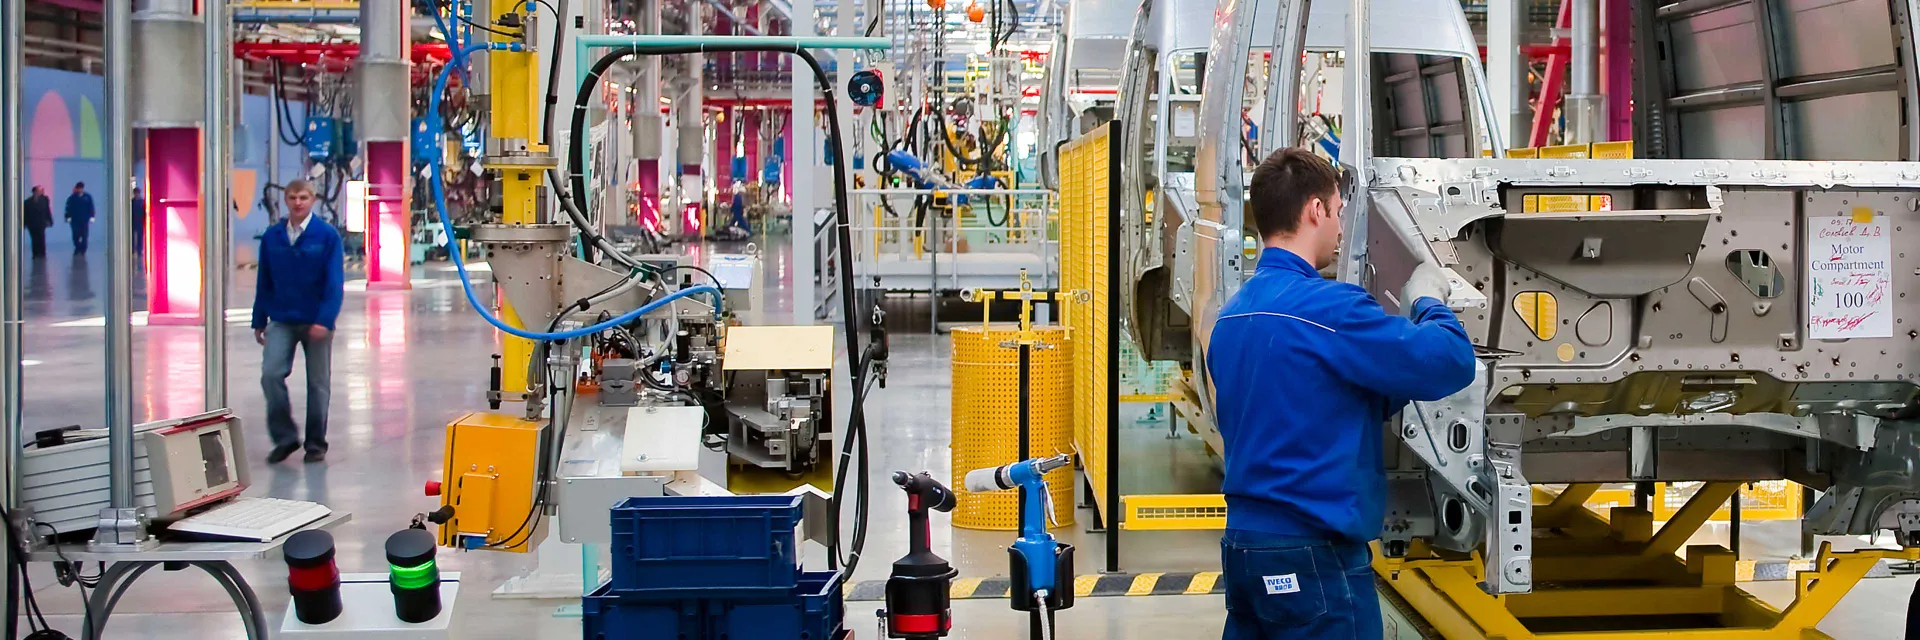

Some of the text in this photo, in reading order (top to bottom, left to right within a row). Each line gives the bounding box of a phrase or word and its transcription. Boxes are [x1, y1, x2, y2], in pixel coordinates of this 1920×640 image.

[1831, 244, 1864, 254] Motor
[1811, 260, 1884, 272] Compartment
[1835, 292, 1864, 308] 100
[1267, 577, 1292, 585] IVECO
